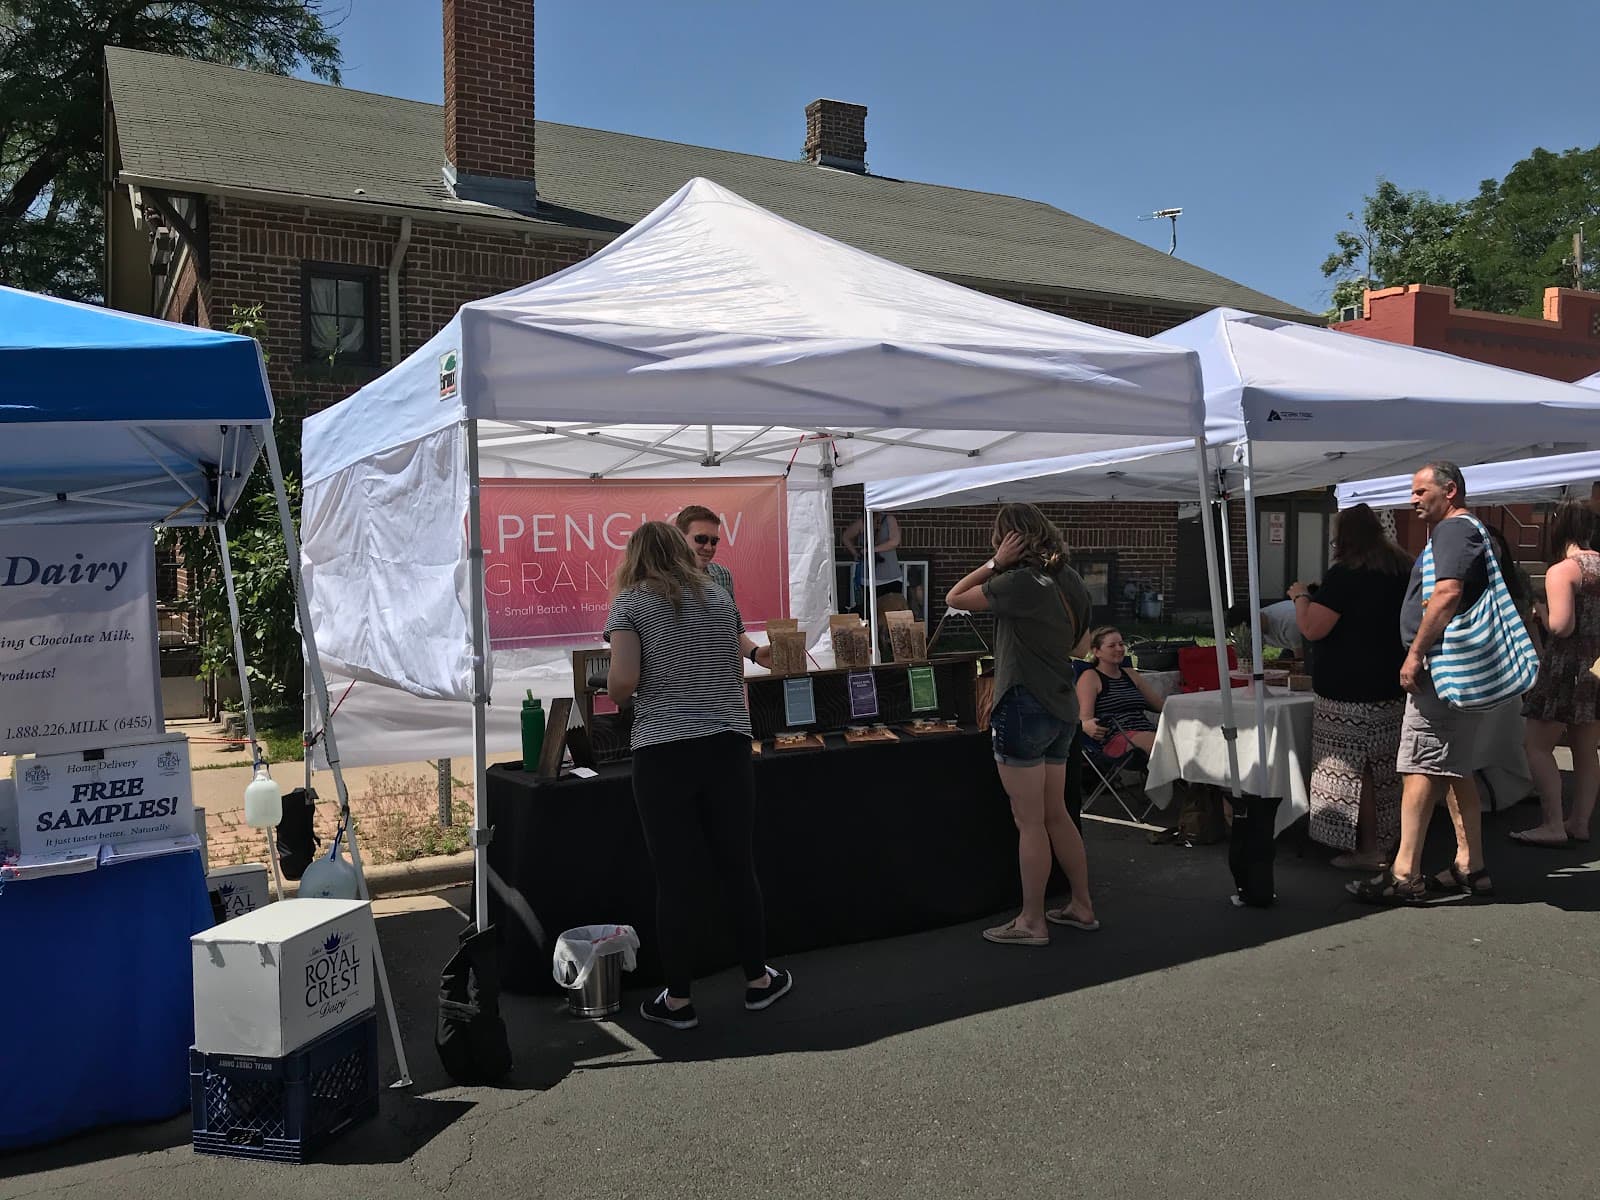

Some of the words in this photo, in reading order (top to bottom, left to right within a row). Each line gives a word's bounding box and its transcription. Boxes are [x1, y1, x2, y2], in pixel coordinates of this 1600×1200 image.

[0, 553, 128, 591] Dairy
[484, 559, 609, 596] GRAN
[504, 606, 535, 617] Small
[537, 604, 568, 615] Batch
[0, 636, 25, 650] ing
[29, 633, 95, 647] Chocolate
[99, 629, 135, 642] Milk,
[0, 667, 56, 681] roducts!
[6, 719, 109, 740] 1.888.226.MILK
[113, 715, 152, 732] (6455)
[67, 764, 97, 774] Home
[99, 759, 138, 770] Delivery
[70, 777, 144, 804] FREE
[36, 796, 178, 832] SAMPLES!
[46, 839, 53, 847] It
[53, 838, 71, 848] just
[73, 834, 97, 843] tastes
[224, 894, 256, 909] YAL
[305, 944, 360, 987] ROYAL
[305, 964, 360, 1007] CREST
